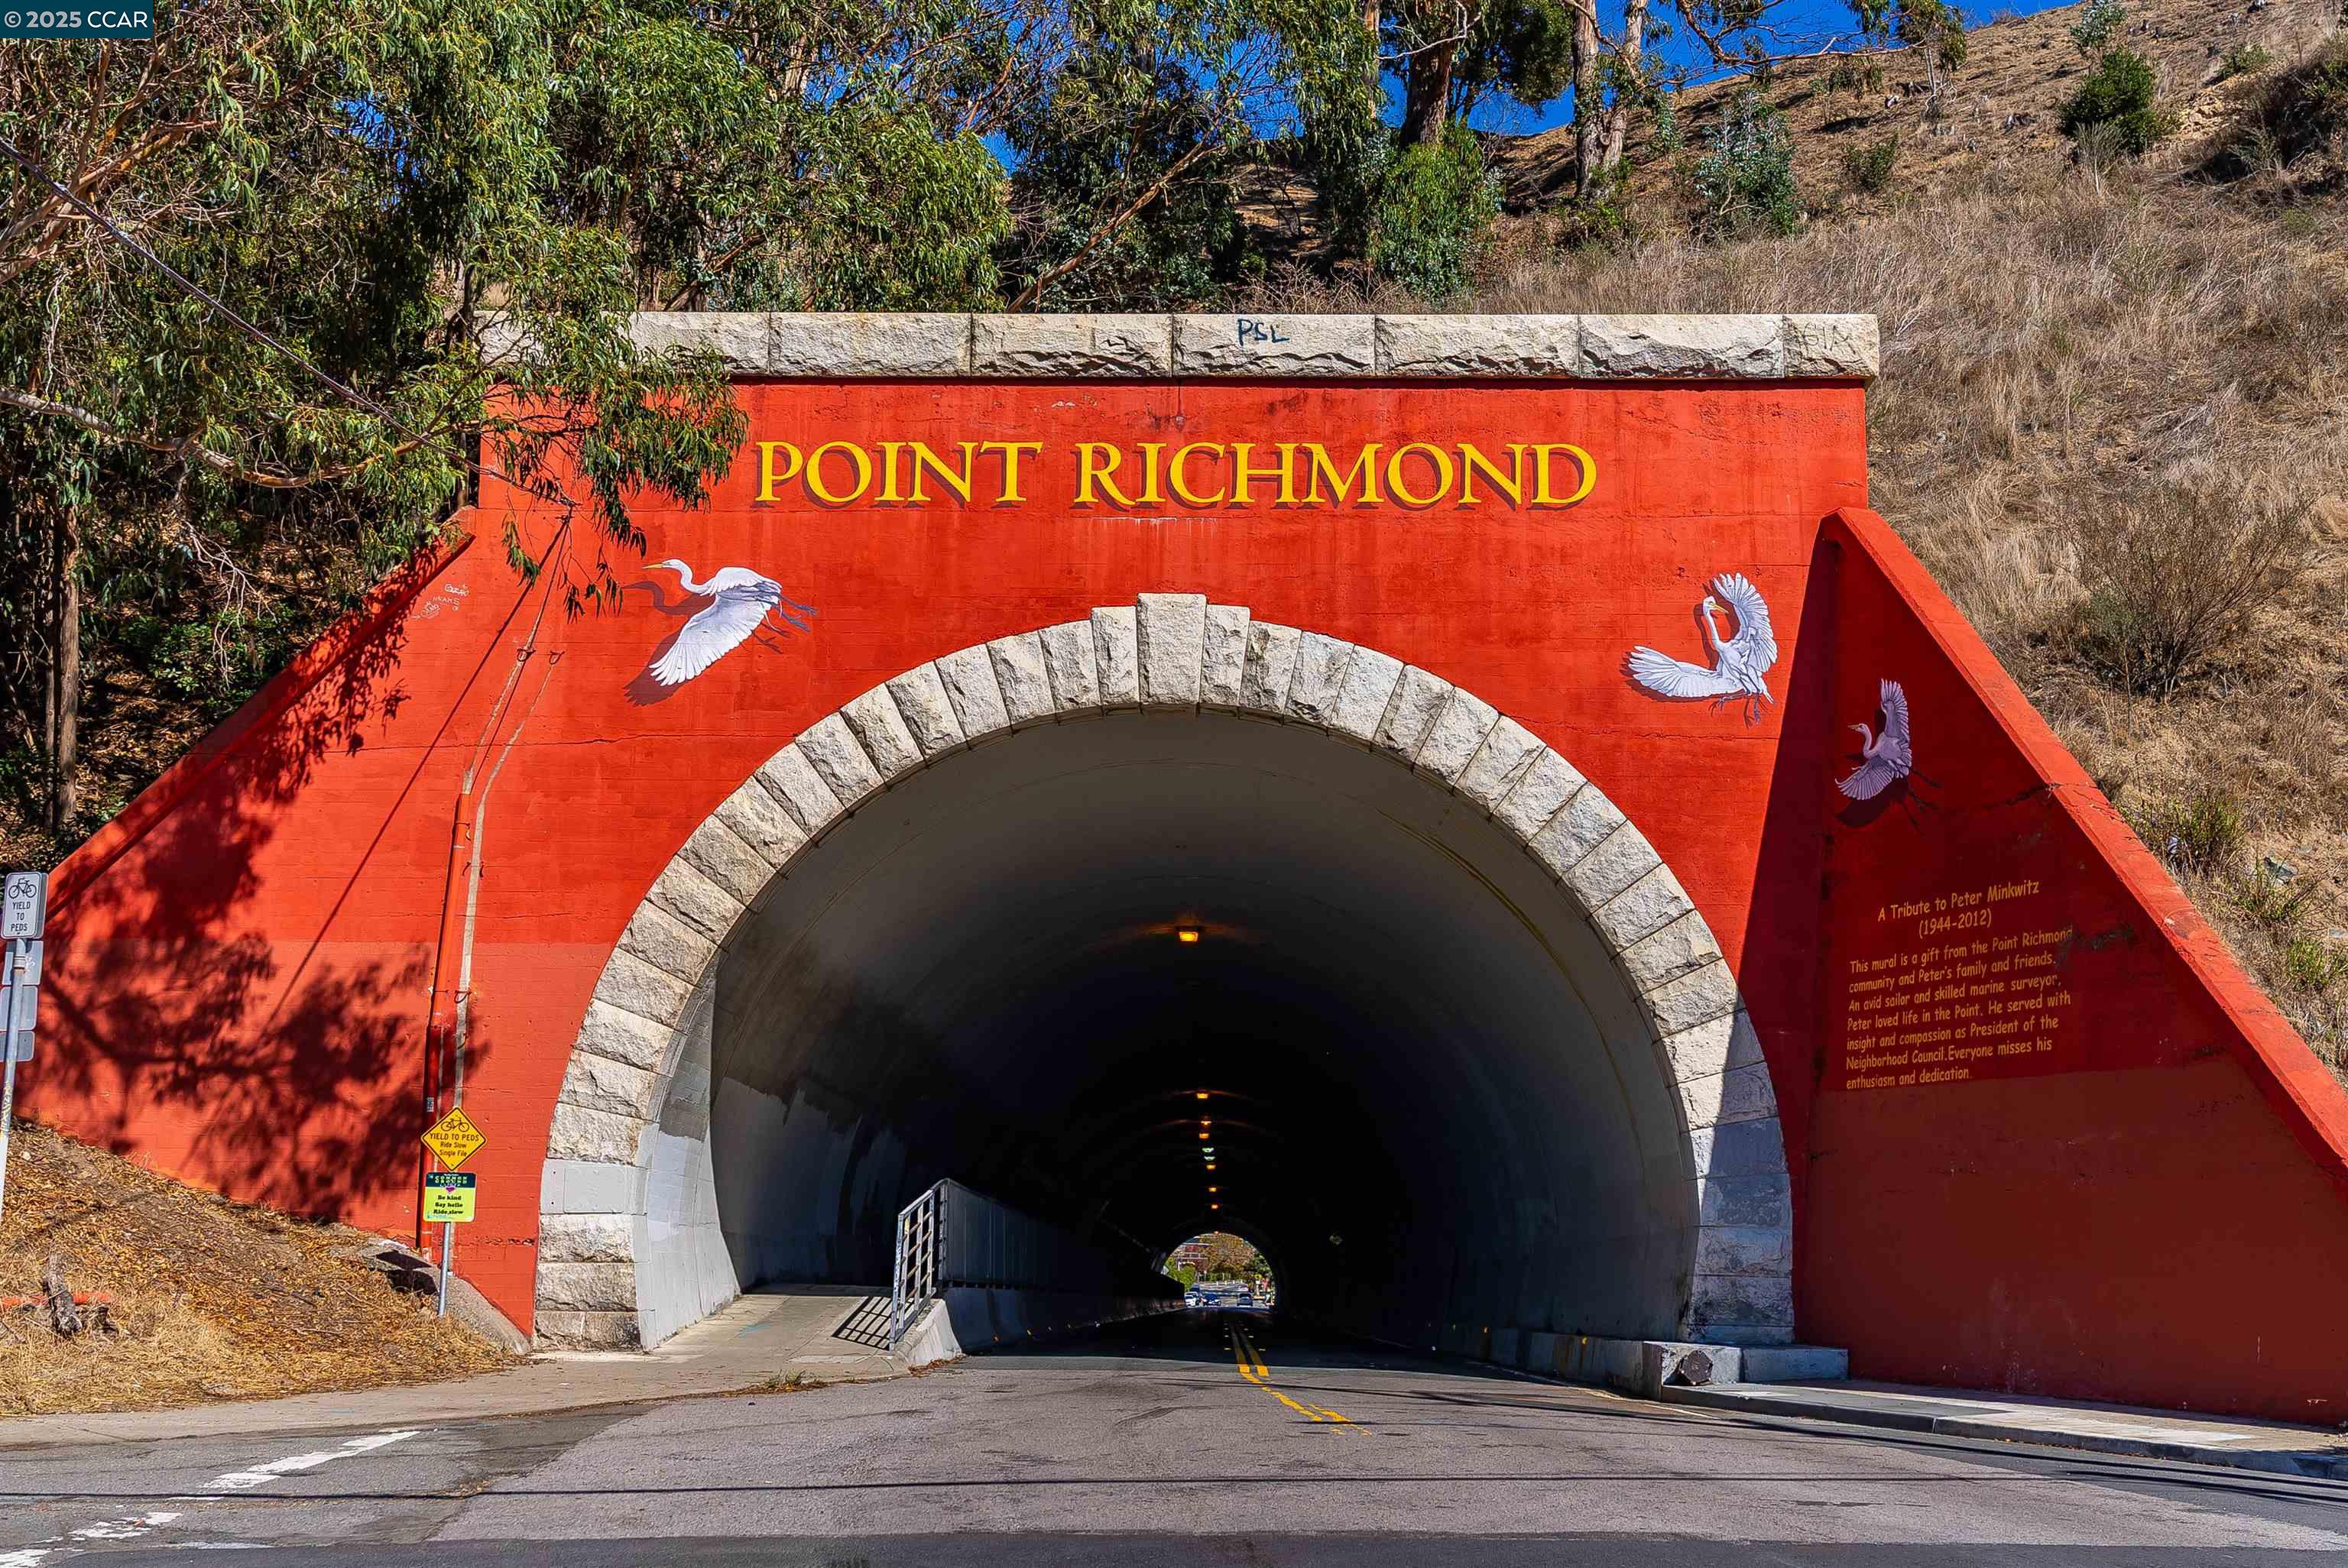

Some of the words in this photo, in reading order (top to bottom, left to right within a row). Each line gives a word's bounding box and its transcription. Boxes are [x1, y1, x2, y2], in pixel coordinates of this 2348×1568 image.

[753, 440, 1044, 505] POINT
[1072, 442, 1598, 508] RICHMOND
[12, 901, 31, 910] YIELD
[16, 912, 25, 921] TO
[1877, 907, 1886, 922] A
[1890, 900, 1931, 919] Tribute
[1935, 897, 1947, 912] to
[1951, 892, 1982, 909] Peter
[1987, 880, 2039, 902] Minkwitz
[11, 923, 28, 932] PEDS
[1918, 908, 1993, 939] (1944-2012)
[1850, 959, 1869, 974] This
[1872, 953, 1897, 971] mural
[1900, 953, 1909, 966] is
[1912, 954, 1918, 964] a
[1921, 948, 1940, 967] gift
[1944, 944, 1967, 961] from
[1971, 940, 1988, 954] the
[1992, 935, 2019, 952] Point
[2022, 924, 2073, 948] Richmond
[1849, 975, 1896, 993] community
[1899, 970, 1915, 986] and
[1918, 966, 1952, 983] Peter's
[1956, 959, 1987, 979] family
[1991, 955, 2010, 972] and
[2014, 950, 2056, 970] friends.
[1847, 1018, 1872, 1032] Peter
[1875, 1012, 1899, 1028] loved
[1902, 1009, 1918, 1025] life
[1922, 1009, 1931, 1022] in
[1934, 1006, 1951, 1022] the
[1954, 1003, 1983, 1019] Point.
[1988, 999, 2003, 1015] He
[2006, 993, 2043, 1012] served
[2047, 990, 2071, 1008] with
[1848, 999, 1860, 1012] An
[1863, 995, 1882, 1011] avid
[1885, 992, 1911, 1007] sailor
[1914, 987, 1931, 1003] and
[1934, 983, 1966, 1001] skilled
[1970, 980, 2005, 996] marine
[1847, 1035, 1876, 1053] insight
[1879, 1032, 1896, 1047] and
[1899, 1027, 1951, 1047] compassion
[1954, 1027, 1967, 1038] as
[1970, 1019, 2019, 1037] President
[2023, 1015, 2035, 1032] of
[2040, 1014, 2059, 1030] the
[1846, 1050, 1909, 1072] Neighborhood
[1997, 1040, 2032, 1056] misses
[2036, 1036, 2053, 1051] his
[1846, 1074, 1896, 1090] enthusiasm
[1899, 1069, 1915, 1085] and
[430, 1132, 449, 1141] YIELD
